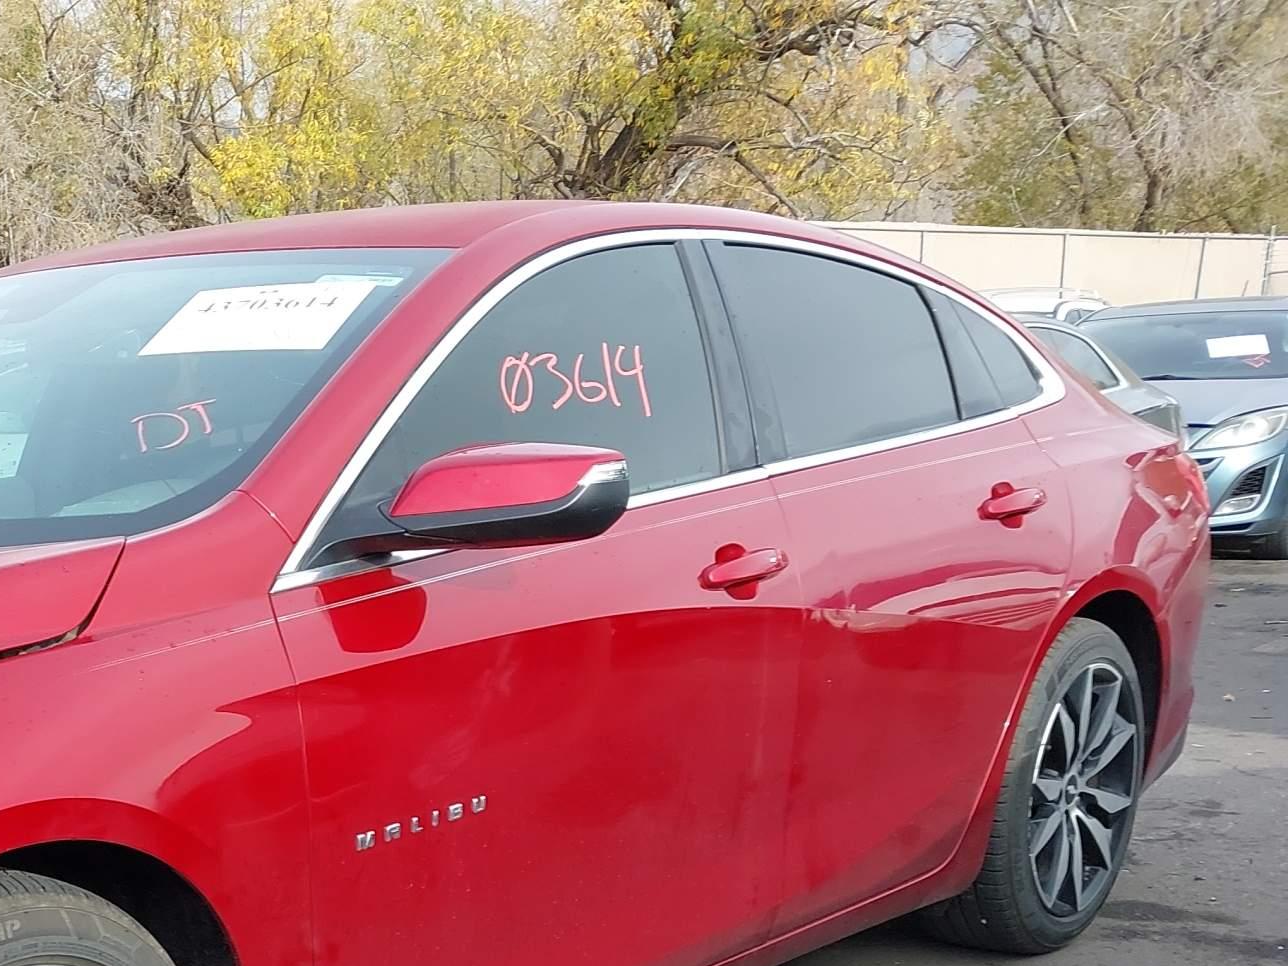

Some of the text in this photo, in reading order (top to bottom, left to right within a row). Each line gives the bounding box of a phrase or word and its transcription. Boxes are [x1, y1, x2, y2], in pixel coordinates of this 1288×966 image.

[501, 342, 652, 417] 03614
[130, 399, 217, 452] DT
[355, 795, 487, 852] MALIBU
